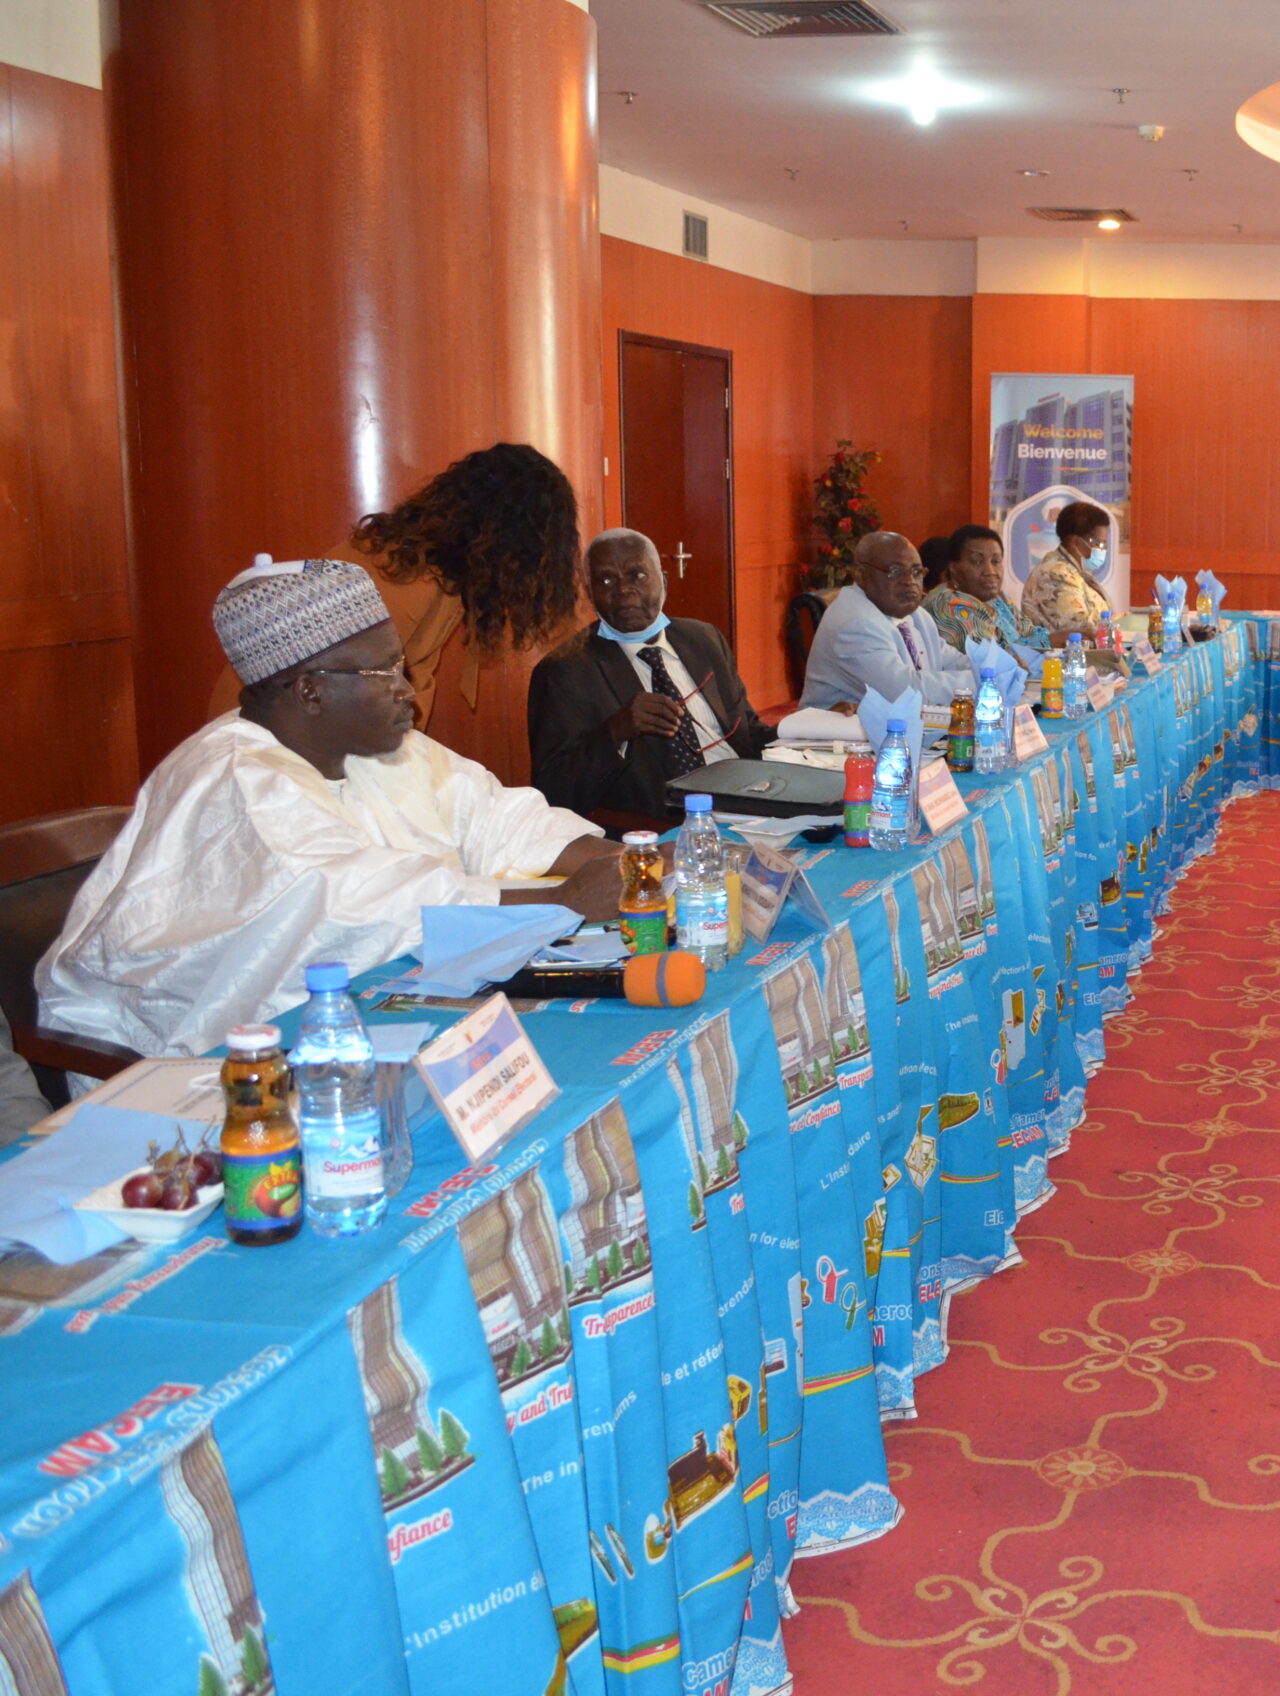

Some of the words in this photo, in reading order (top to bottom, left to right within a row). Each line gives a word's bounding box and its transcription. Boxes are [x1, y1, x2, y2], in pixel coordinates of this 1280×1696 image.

[1023, 424, 1105, 439] Welcome
[1017, 443, 1108, 460] Bienvenue
[760, 1232, 776, 1247] for
[673, 1362, 690, 1381] et
[520, 1397, 547, 1423] and
[559, 1460, 579, 1478] in
